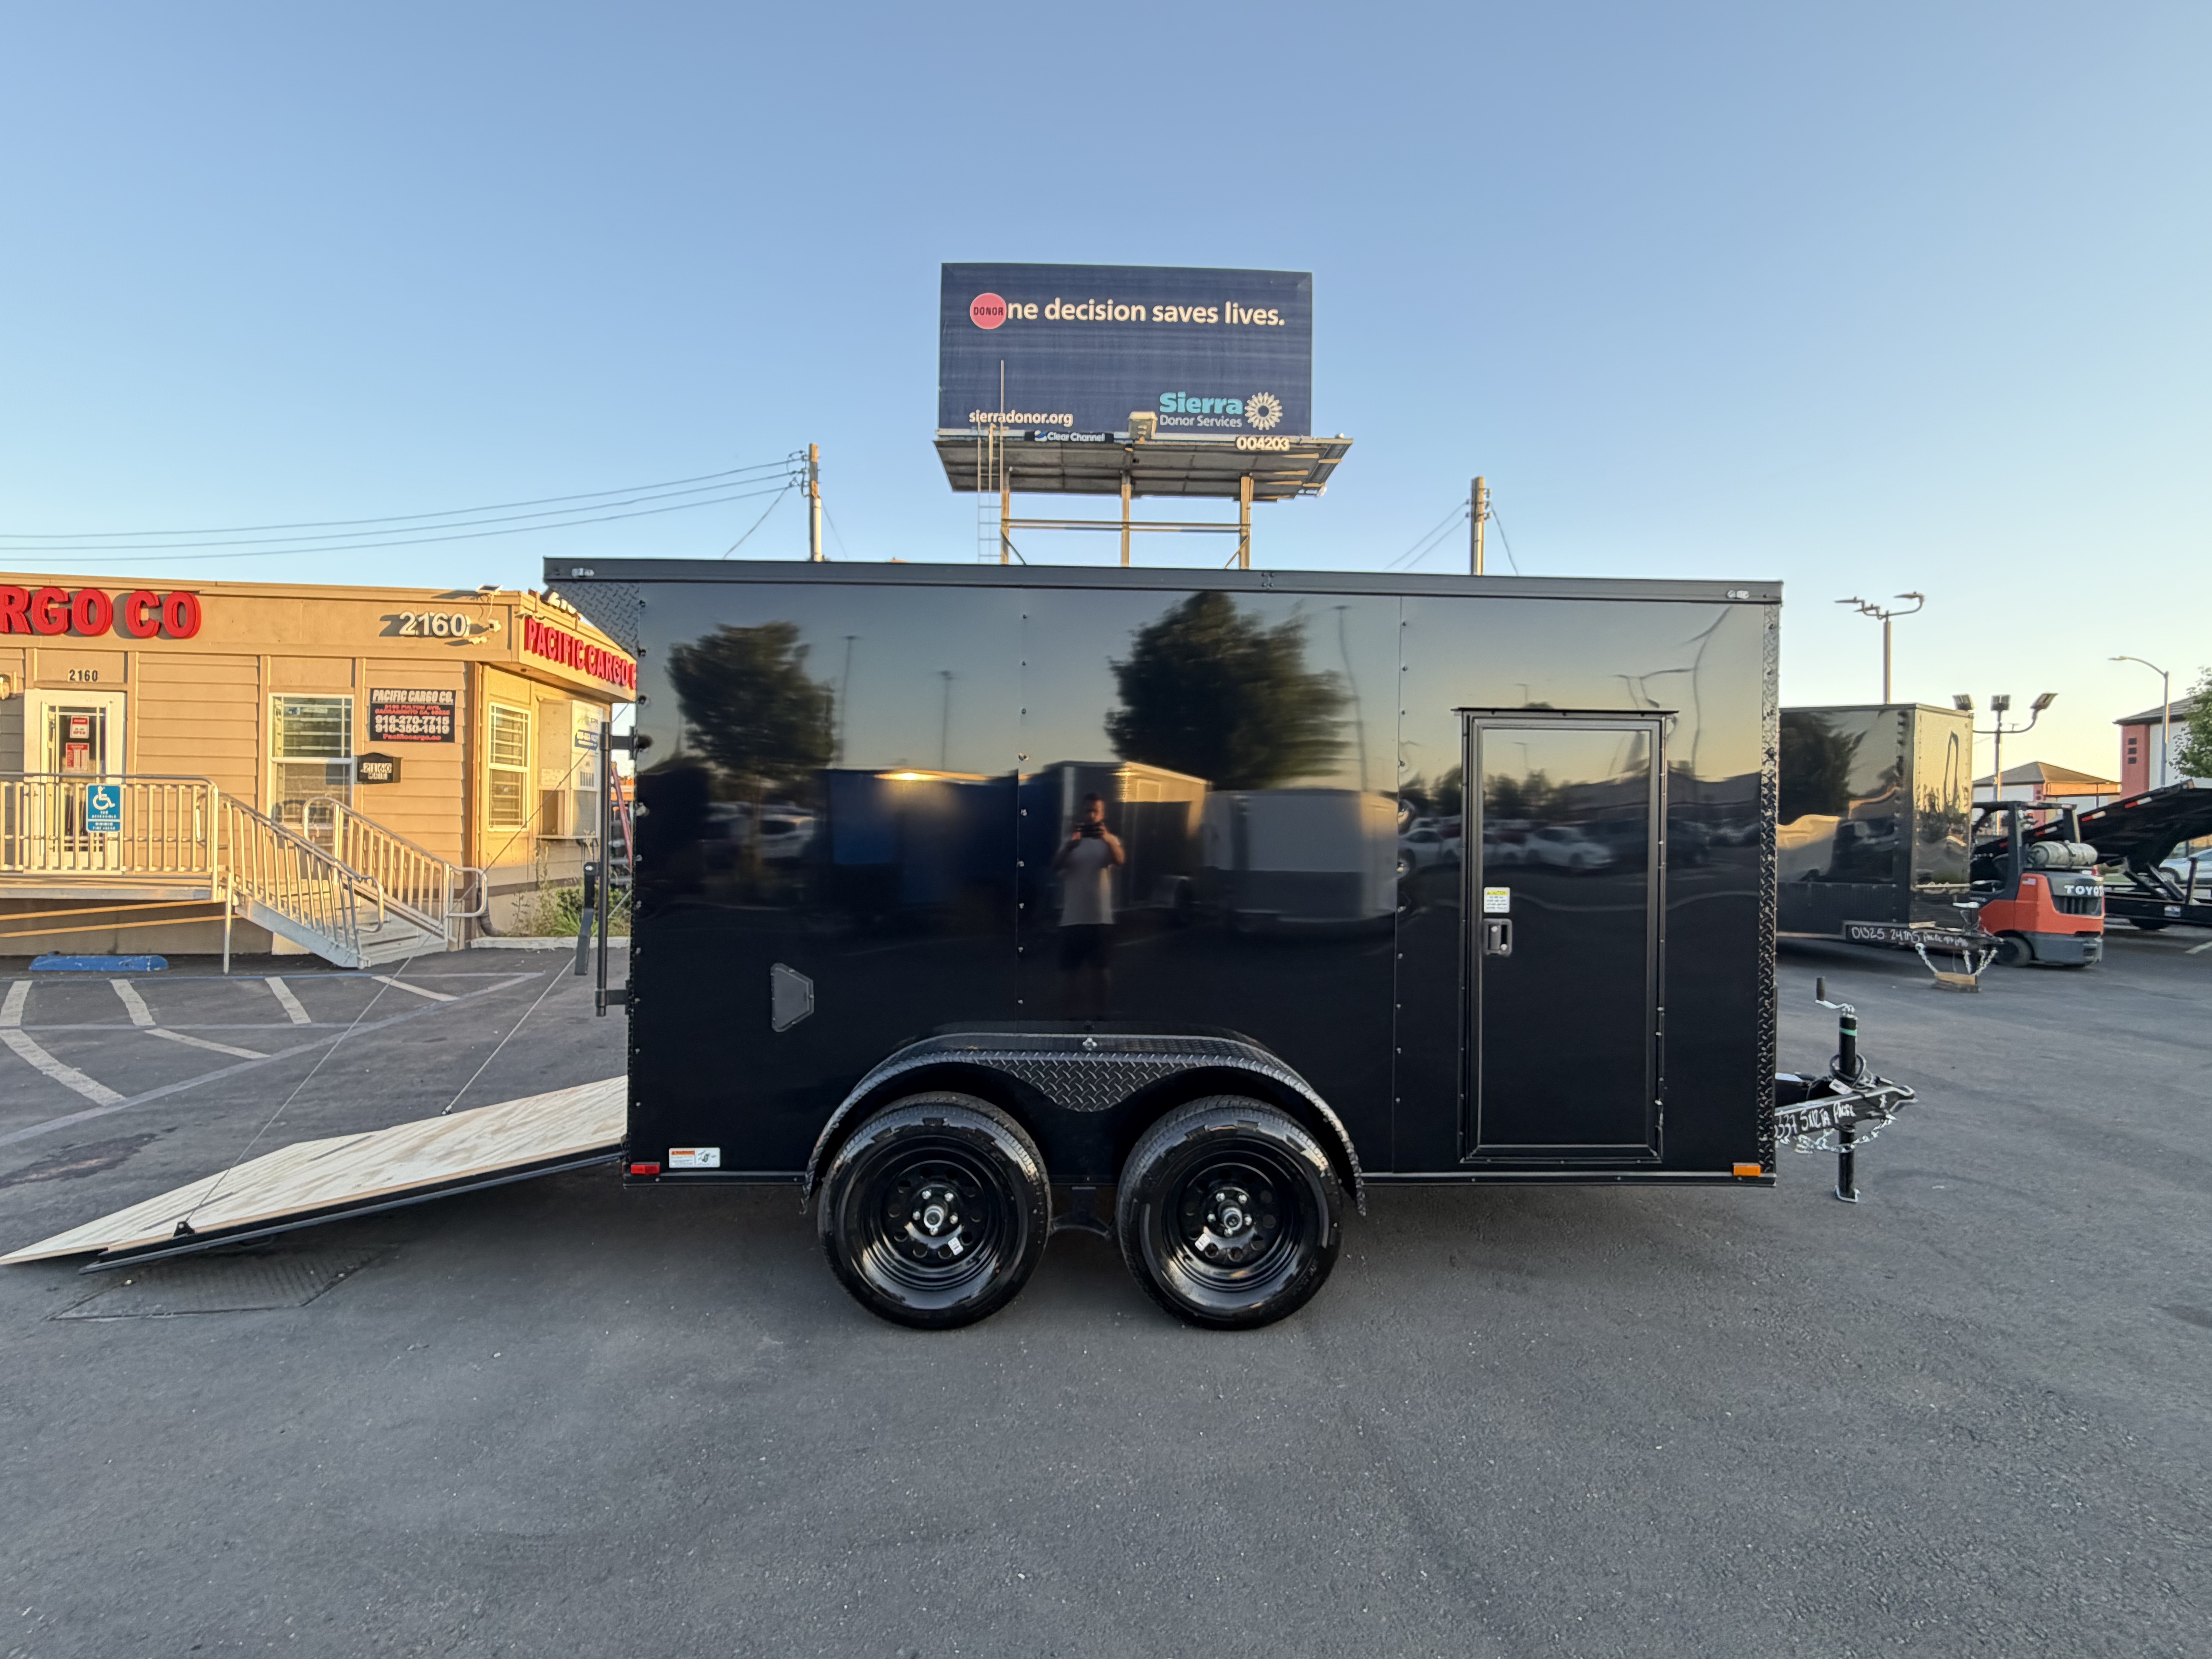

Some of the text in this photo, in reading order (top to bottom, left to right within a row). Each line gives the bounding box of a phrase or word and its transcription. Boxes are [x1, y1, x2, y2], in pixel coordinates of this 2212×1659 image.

[973, 306, 1004, 316] DONOR
[1044, 297, 1146, 321] decision
[1152, 305, 1219, 323] saves
[1225, 301, 1285, 326] lives.
[1159, 391, 1243, 414] Sierra
[969, 409, 1073, 427] sierradonor.org
[1160, 415, 1242, 428] Donor Services
[1047, 431, 1105, 441] Clear Channel
[1237, 435, 1290, 451] 004203
[125, 590, 201, 639] CO
[399, 611, 470, 637] 2160
[524, 618, 585, 670] PACIFIC
[585, 644, 629, 686] CARGO
[69, 669, 98, 682] 2160
[373, 690, 454, 704] PACIFIC CARGO CO.
[375, 715, 450, 725] 916-270-7715
